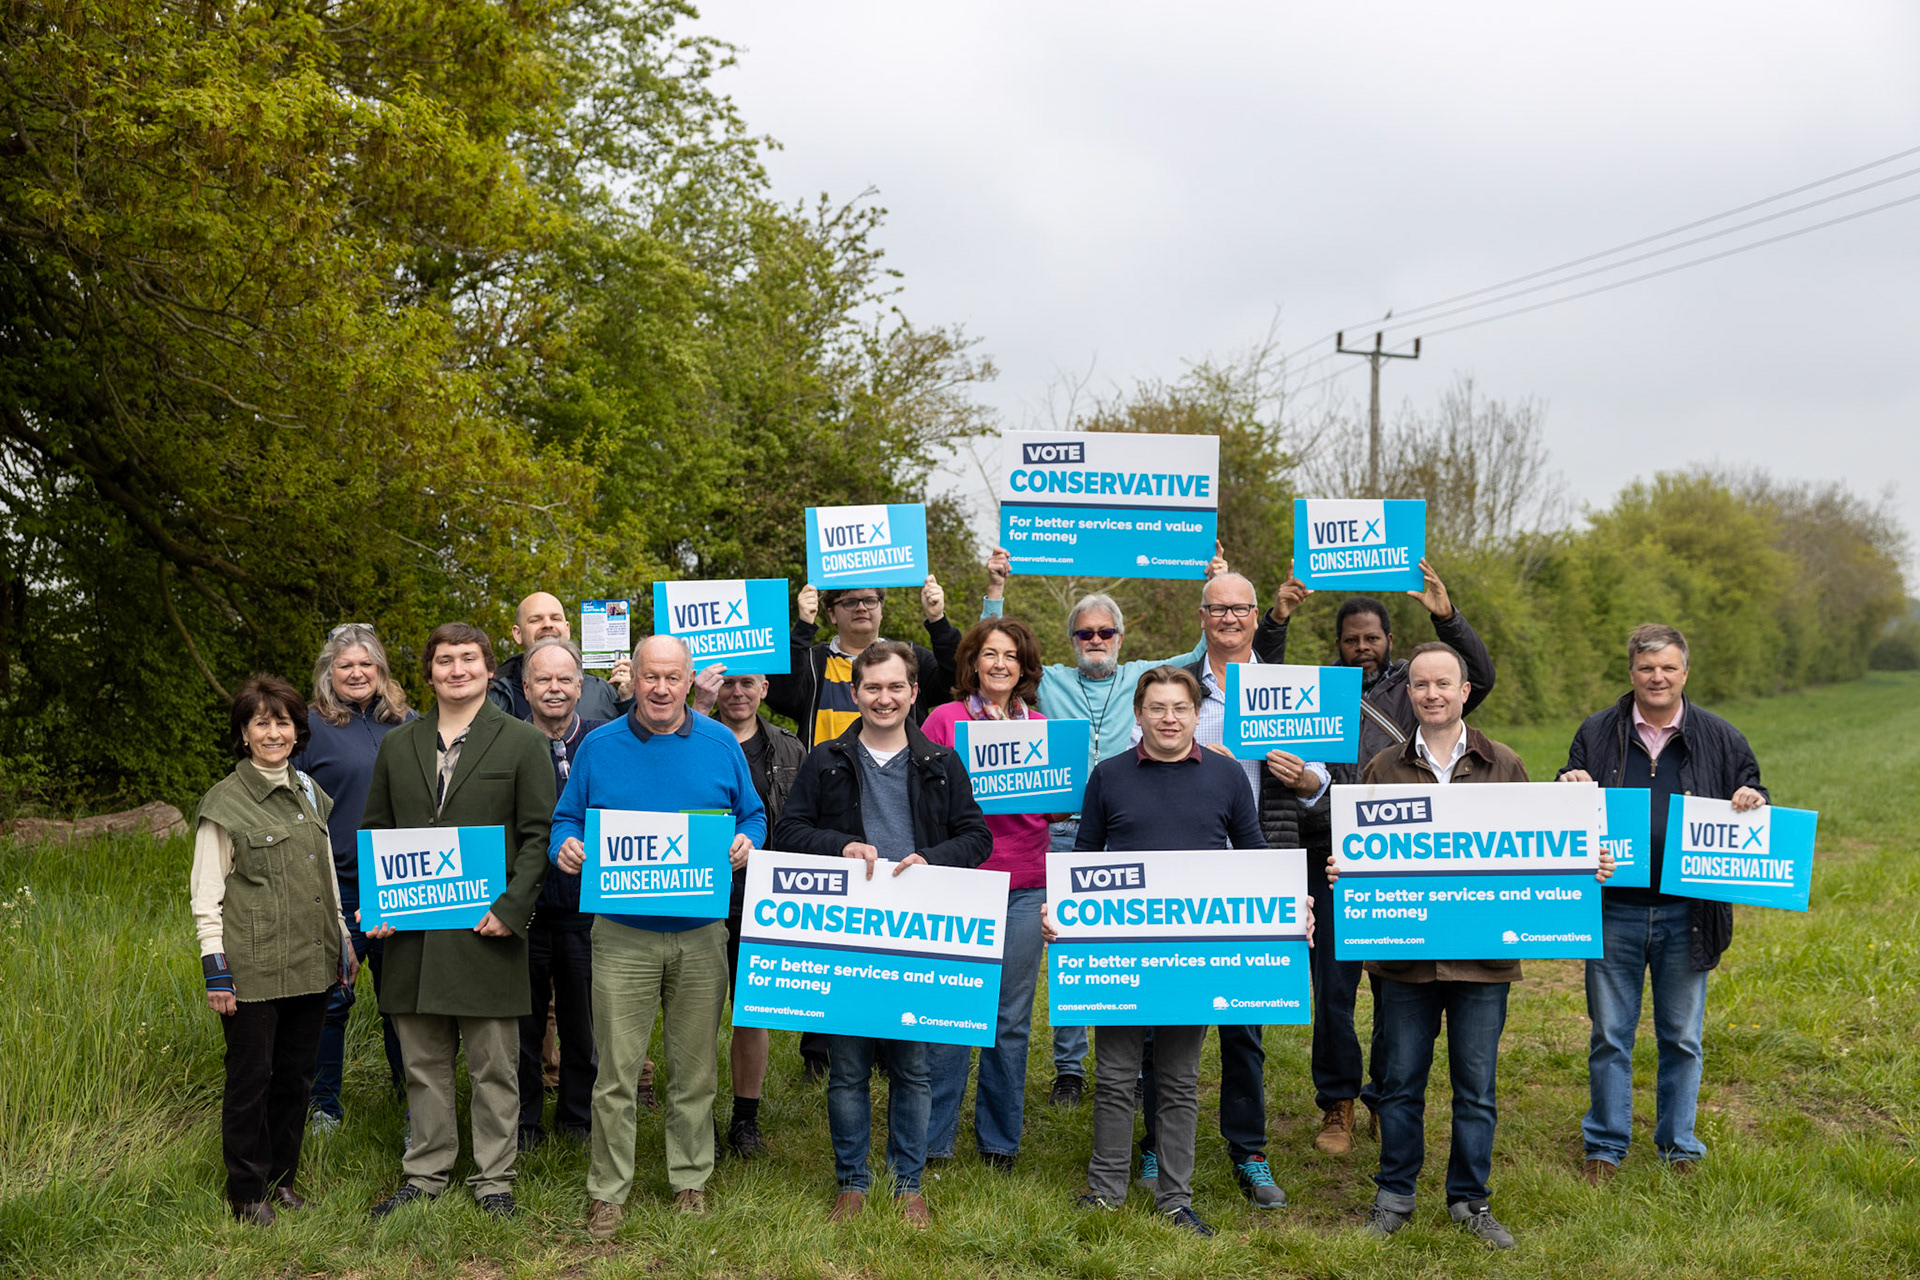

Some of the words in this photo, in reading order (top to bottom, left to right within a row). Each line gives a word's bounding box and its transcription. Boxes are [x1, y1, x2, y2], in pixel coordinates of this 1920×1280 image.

[1026, 444, 1081, 462] VOTE
[1010, 469, 1210, 497] CONSERVATIVE
[824, 523, 866, 548] VOTE
[1009, 516, 1031, 527] For
[1035, 516, 1075, 529] better
[1078, 519, 1132, 530] services
[1136, 520, 1161, 532] and
[1165, 521, 1203, 533] value
[1314, 520, 1359, 544] VOTE
[1009, 529, 1028, 541] for
[1031, 532, 1077, 545] money
[822, 545, 914, 572] CONSERVATIVE
[1151, 556, 1209, 567] Conservatives
[1309, 547, 1409, 571] CONSERVATIVE
[674, 601, 722, 628] VOTE
[1246, 687, 1292, 711] VOTE
[1240, 716, 1343, 739] CONSERVATIVE
[975, 741, 1022, 767] VOTE
[970, 767, 1072, 795] CONSERVATIVE
[1360, 800, 1427, 823] VOTE
[1342, 830, 1587, 860] CONSERVATIVE
[1690, 822, 1740, 849] VOTE
[607, 835, 658, 862] VOTE
[381, 851, 432, 880] VOTE
[1680, 855, 1795, 880] CONSERVATIVE
[601, 868, 713, 891] CONSERVATIVE
[777, 871, 843, 892] VOTE
[1075, 866, 1141, 889] VOTE
[378, 879, 490, 910] CONSERVATIVE
[1344, 889, 1371, 902] For
[1375, 888, 1423, 902] better
[1428, 887, 1495, 901] services
[1499, 887, 1531, 901] and
[1535, 887, 1582, 900] value
[754, 899, 996, 946] CONSERVATIVE
[1056, 896, 1296, 926] CONSERVATIVE
[1344, 906, 1368, 919] for
[1371, 906, 1428, 921] money
[1344, 936, 1425, 945] conservatives.com
[1520, 932, 1592, 942] Conservatives
[749, 955, 777, 971] For
[781, 957, 831, 975] better
[833, 964, 899, 981] services
[903, 970, 934, 984] and
[938, 972, 984, 988] value
[1058, 955, 1085, 968] For
[1089, 953, 1137, 968] better
[1141, 953, 1206, 968] services
[1210, 953, 1241, 967] and
[1245, 953, 1291, 967] value
[747, 972, 772, 986] for
[775, 976, 831, 995] money
[1058, 972, 1081, 985] for
[1085, 972, 1140, 988] money
[744, 1004, 825, 1018] conservatives.com
[1057, 1002, 1137, 1011] conservatives.com
[1230, 998, 1300, 1008] Conservatives
[919, 1015, 988, 1030] Conservatives
